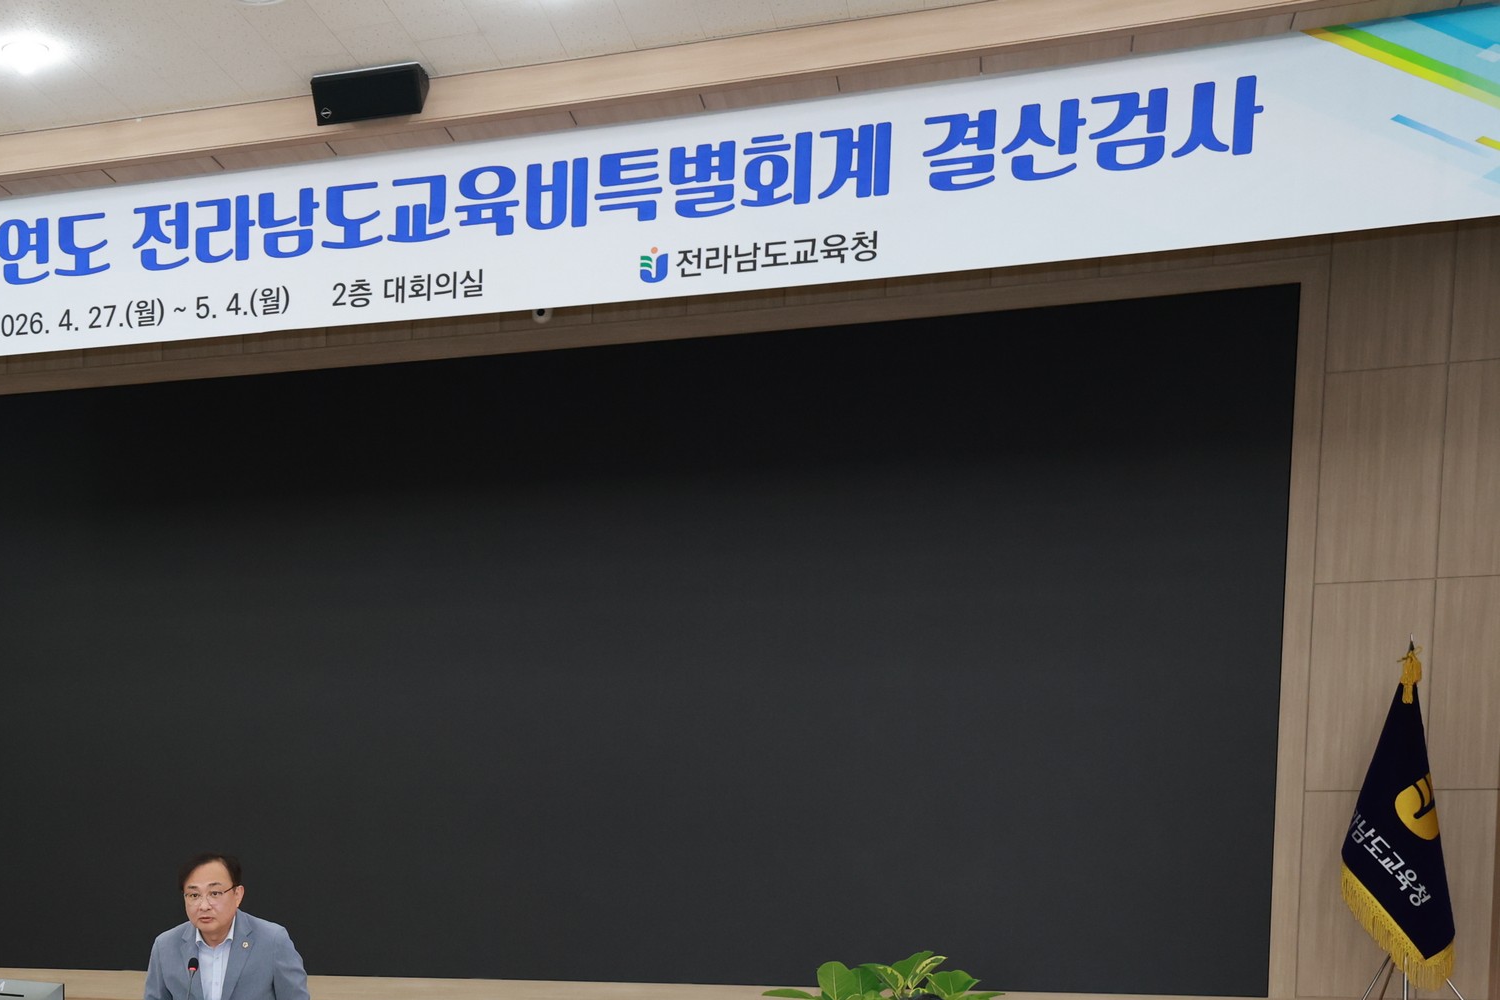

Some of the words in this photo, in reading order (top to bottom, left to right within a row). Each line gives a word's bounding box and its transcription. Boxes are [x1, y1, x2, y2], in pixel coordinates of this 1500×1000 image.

[132, 121, 892, 283] 전라남도교육비특별회계
[923, 75, 1264, 192] 결산검사
[676, 230, 879, 278] 전라남도교육청
[59, 308, 79, 331] 4.
[88, 298, 165, 328] 27.(월)
[196, 295, 217, 319] 5.
[226, 285, 290, 316] 4.(월)
[332, 279, 373, 308] 2층
[383, 268, 484, 304] 대회의실
